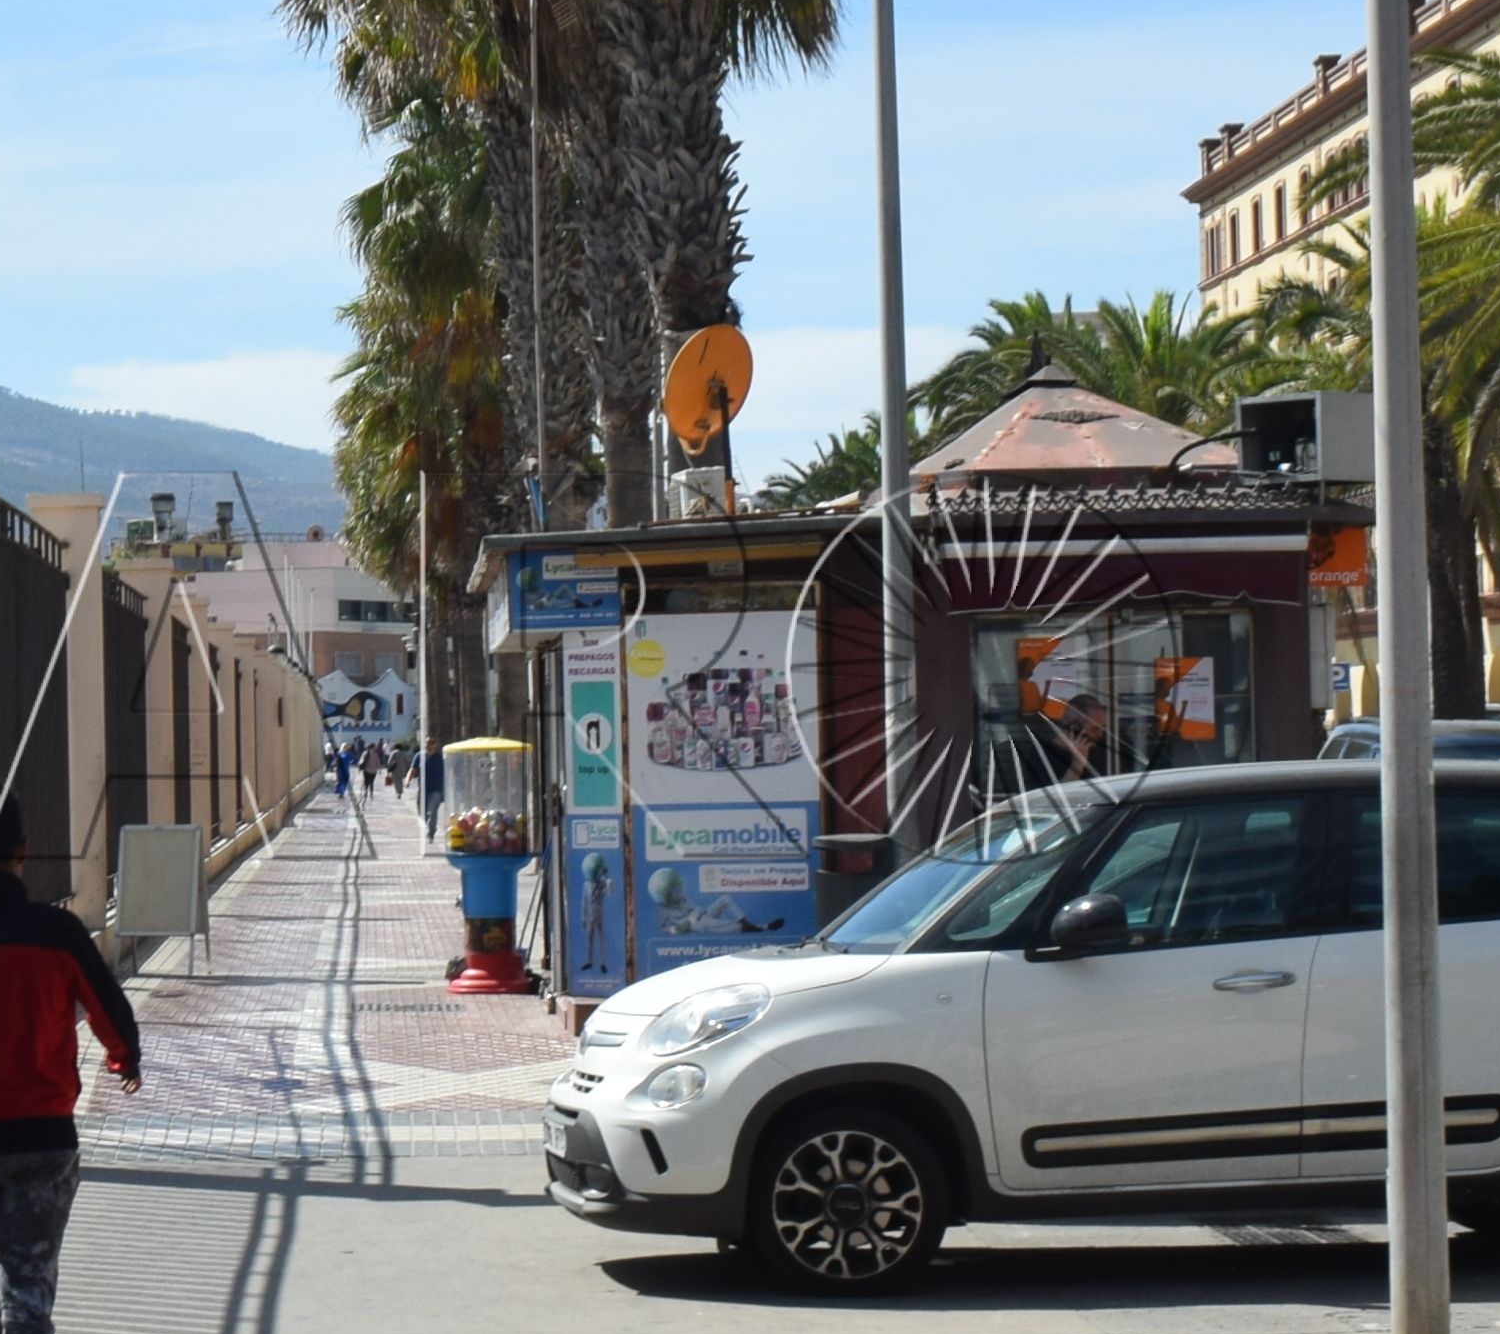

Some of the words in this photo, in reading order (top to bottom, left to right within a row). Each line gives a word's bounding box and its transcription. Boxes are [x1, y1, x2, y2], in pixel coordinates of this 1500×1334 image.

[1309, 569, 1360, 584] orange
[567, 652, 616, 661] PREPAGOS
[567, 667, 616, 676] RECARGAS
[578, 765, 595, 775] top
[597, 766, 610, 775] up
[650, 823, 802, 850] Lycamobile
[720, 877, 777, 888] Disponible
